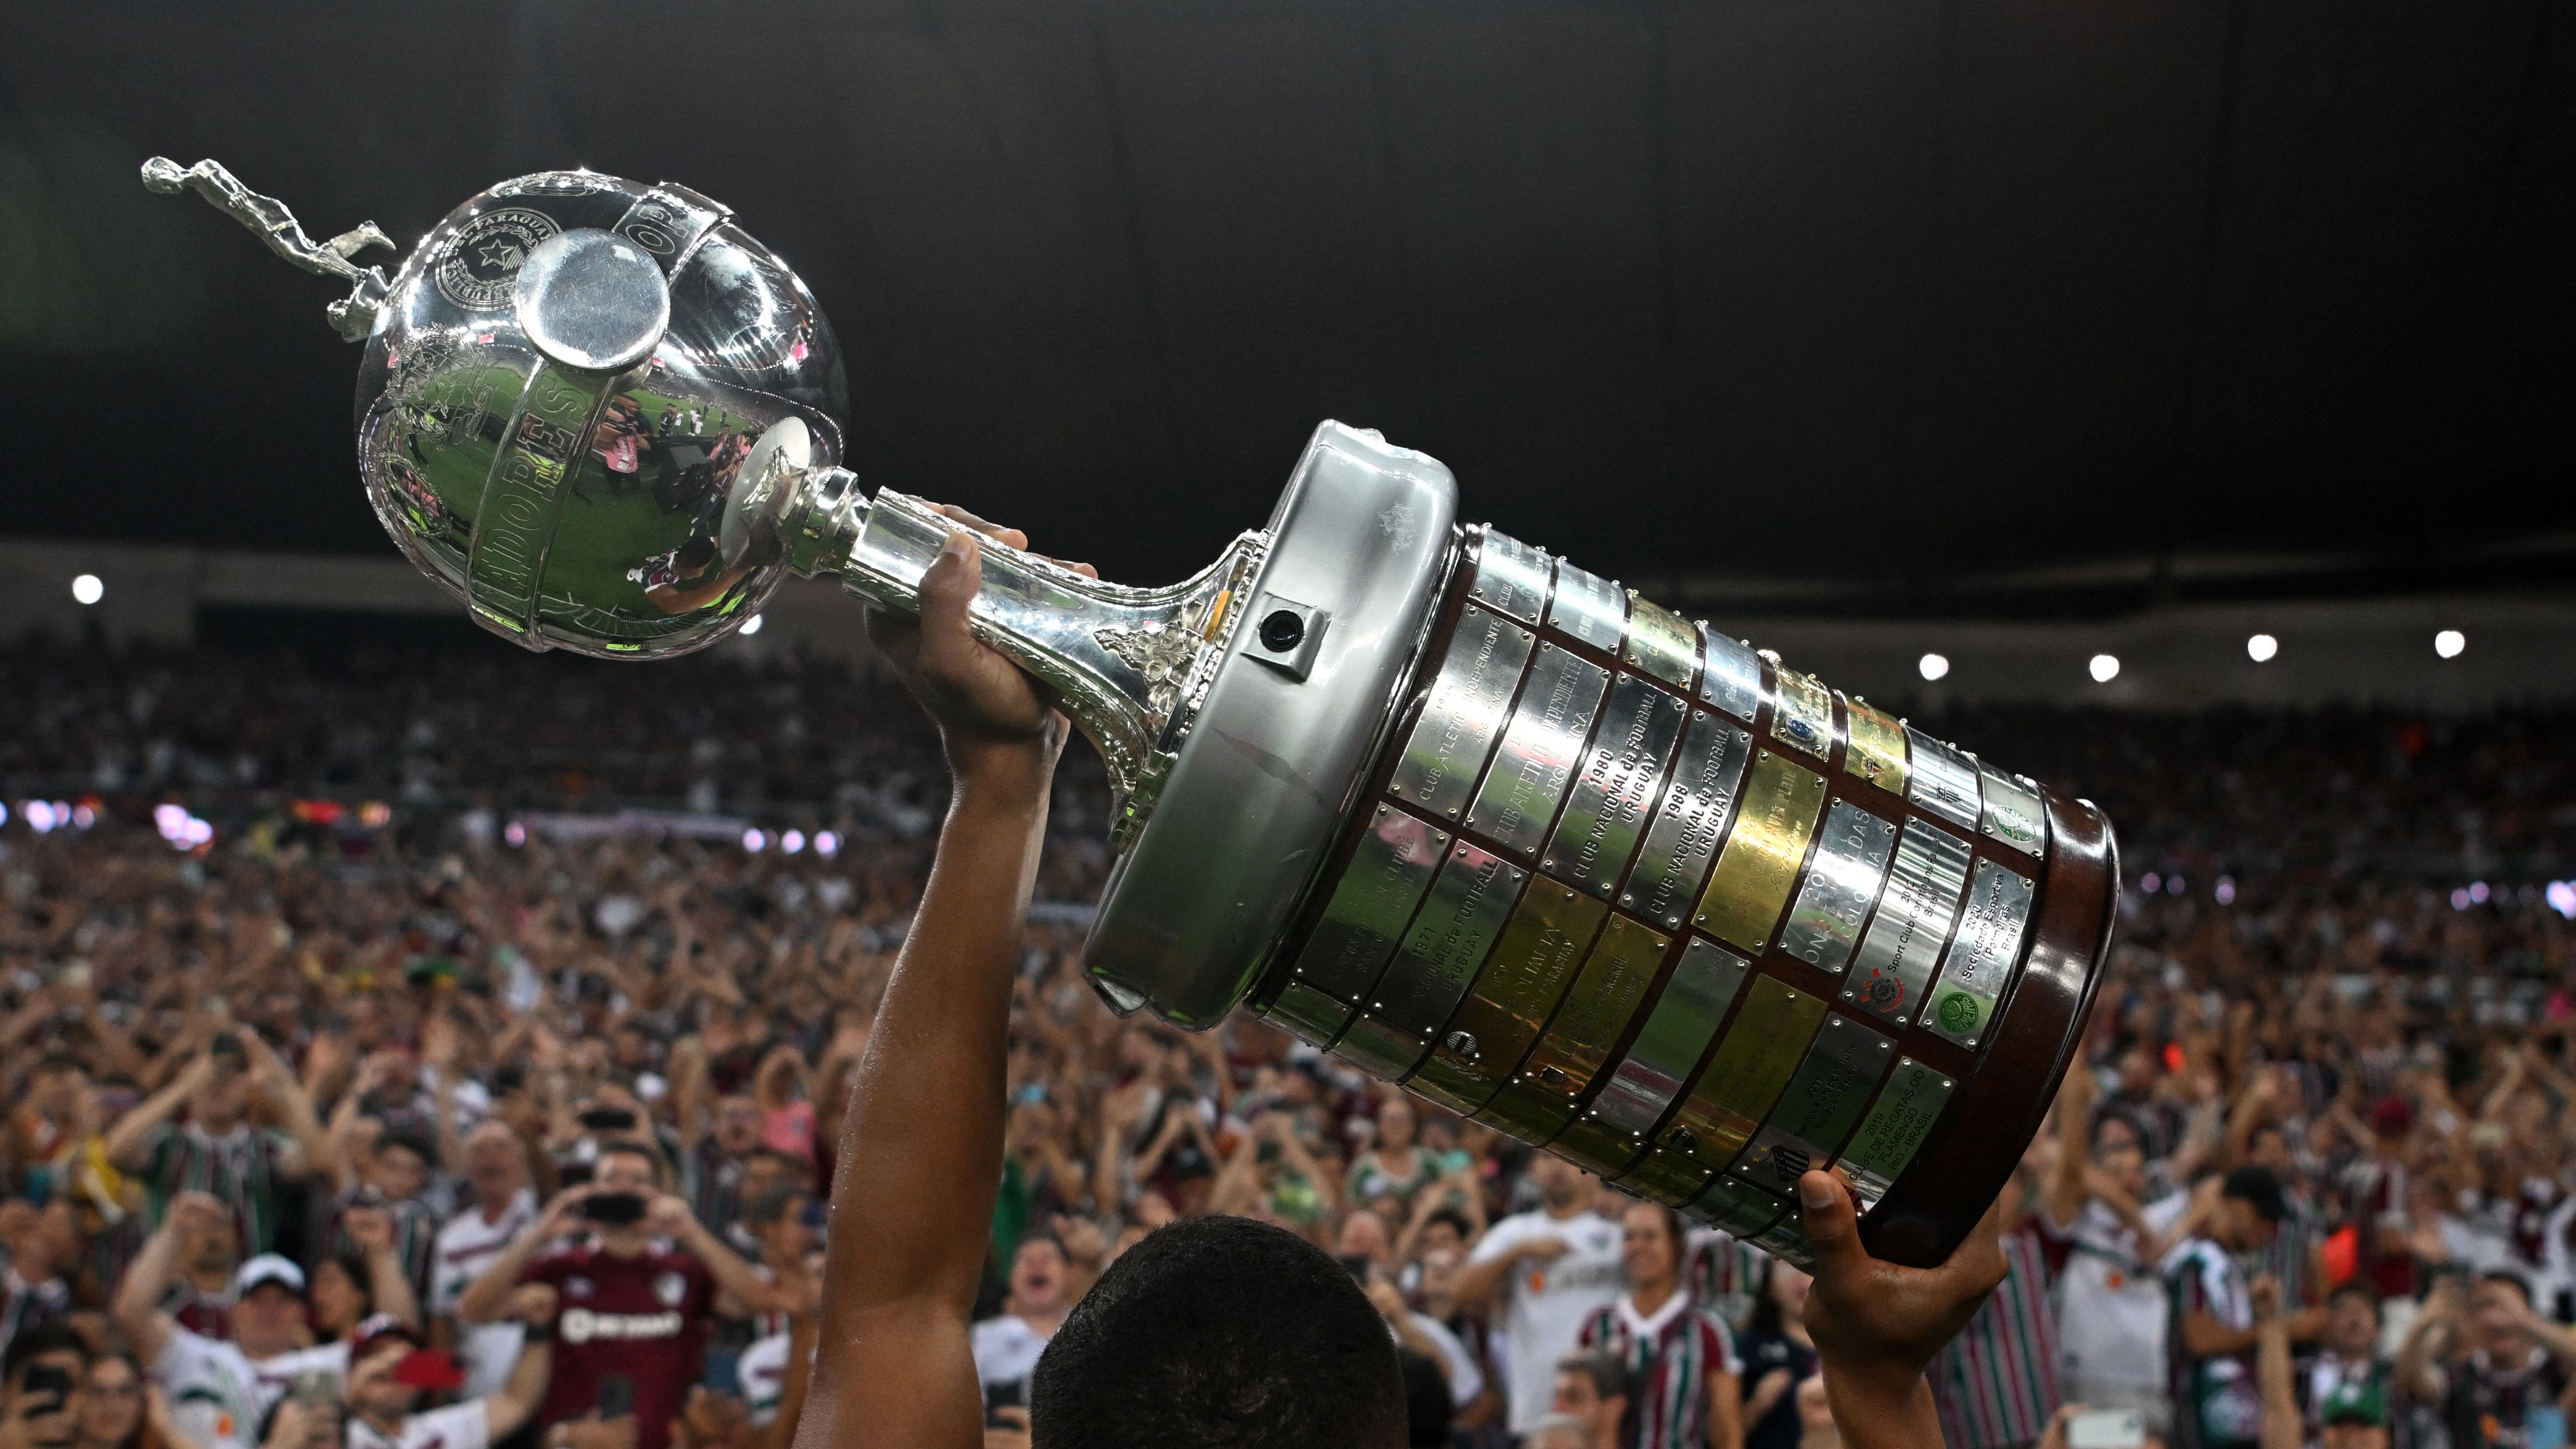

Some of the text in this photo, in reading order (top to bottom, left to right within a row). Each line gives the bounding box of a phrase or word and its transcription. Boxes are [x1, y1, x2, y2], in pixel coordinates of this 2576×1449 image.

[470, 375, 592, 618] TADORES
[1497, 583, 1514, 607] CLUB
[1419, 618, 1504, 802] CLUB ATLETIC INDEPENDIENTE
[1474, 689, 1504, 743] ARGTINA
[1509, 710, 1533, 747] 192
[1541, 706, 1591, 805] ARGEINA
[1573, 690, 1658, 879] CLUB NACIONAL de FOOTBALL
[1588, 747, 1614, 787] 1980
[1619, 751, 1659, 823] URUGUAY
[1664, 782, 1689, 821] 1988
[1493, 806, 1521, 844] CLUB
[1649, 726, 1731, 915] CLUB NACIONAL de FOOTBALL
[1694, 787, 1732, 858] URUGUAY
[1834, 808, 1871, 885] LDAS
[1383, 835, 1415, 882] CLUBE
[1452, 856, 1500, 927] FOOTBALL
[1838, 848, 1882, 939] COLOIA
[1886, 830, 1943, 973] Sport Club Corinthians Pausta
[1899, 879, 1916, 903] 2012
[1923, 888, 1941, 918] Brasil
[1965, 903, 1983, 931] 2020
[1411, 925, 1436, 959] 1971
[1443, 926, 1462, 946] de
[1961, 872, 2006, 980] Sociedade Esportiva
[1984, 904, 2012, 957] Palmeiras
[2000, 918, 2019, 952] Brasil
[1412, 945, 1452, 1001] NACIONAL
[1441, 928, 1483, 991] URUGUAY
[1512, 923, 1561, 996] OLIMPIA
[1793, 1040, 1857, 1139] Santos Futebol Clube
[1805, 1076, 1823, 1098] 2011
[1814, 1098, 1839, 1130] Santos
[1837, 1061, 1860, 1092] Brasil
[1847, 1068, 1926, 1181] CLUBE DE REGATAS DO
[1864, 1111, 1885, 1137] 2019
[1878, 1105, 1920, 1162] FLAMENGO
[1887, 1151, 1906, 1171] RIO
[1904, 1108, 1934, 1146] BRASIL
